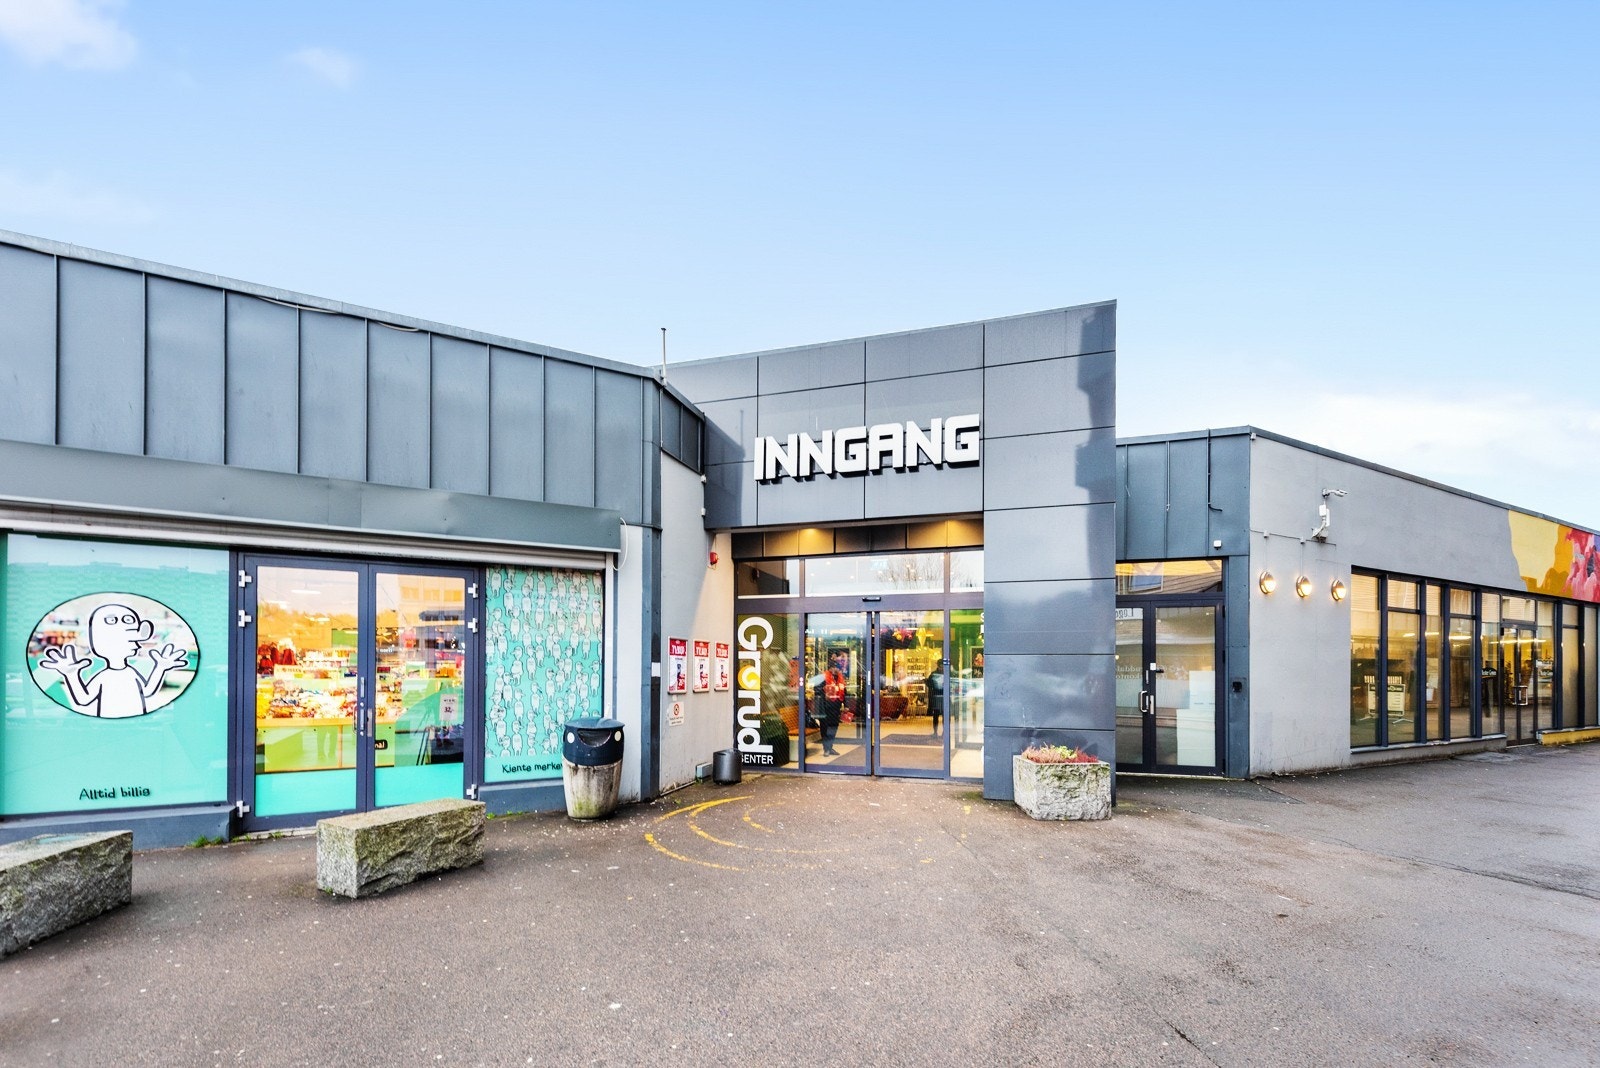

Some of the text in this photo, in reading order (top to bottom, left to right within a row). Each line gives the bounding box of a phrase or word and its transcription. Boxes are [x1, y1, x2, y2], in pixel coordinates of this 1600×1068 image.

[754, 413, 980, 482] INNGANG
[737, 616, 774, 754] Grorud
[502, 764, 532, 774] Kjente
[79, 786, 150, 800] Alltid billig
